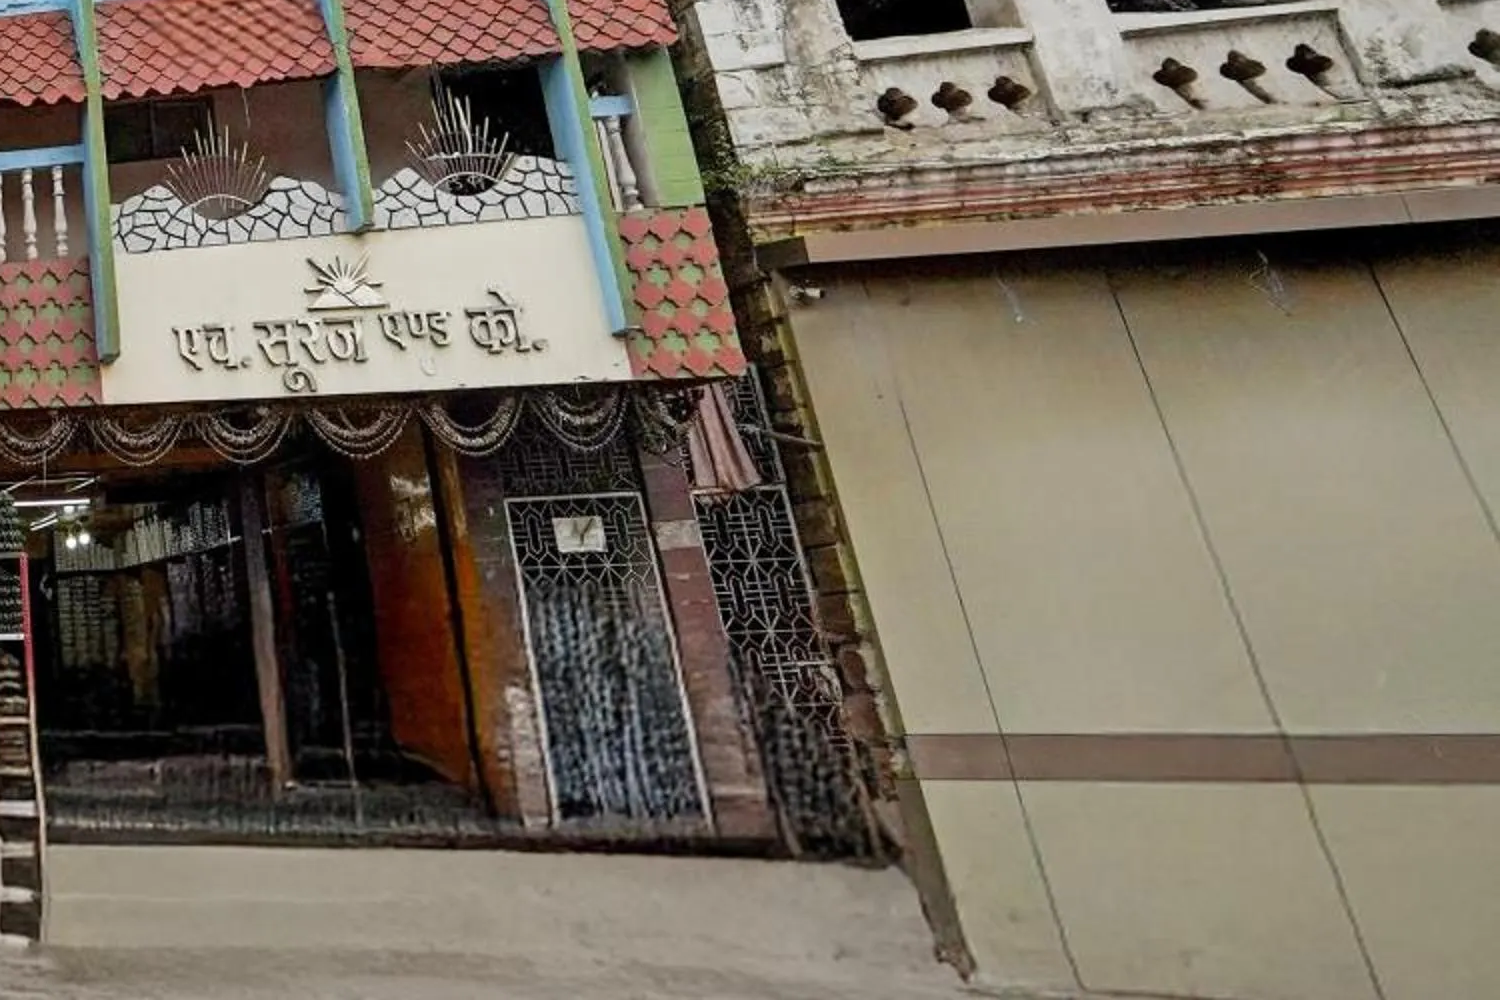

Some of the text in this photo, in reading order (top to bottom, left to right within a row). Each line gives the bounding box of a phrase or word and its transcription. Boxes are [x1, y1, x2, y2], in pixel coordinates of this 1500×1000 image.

[171, 280, 549, 393] एच. सूरज एण्ड को.
